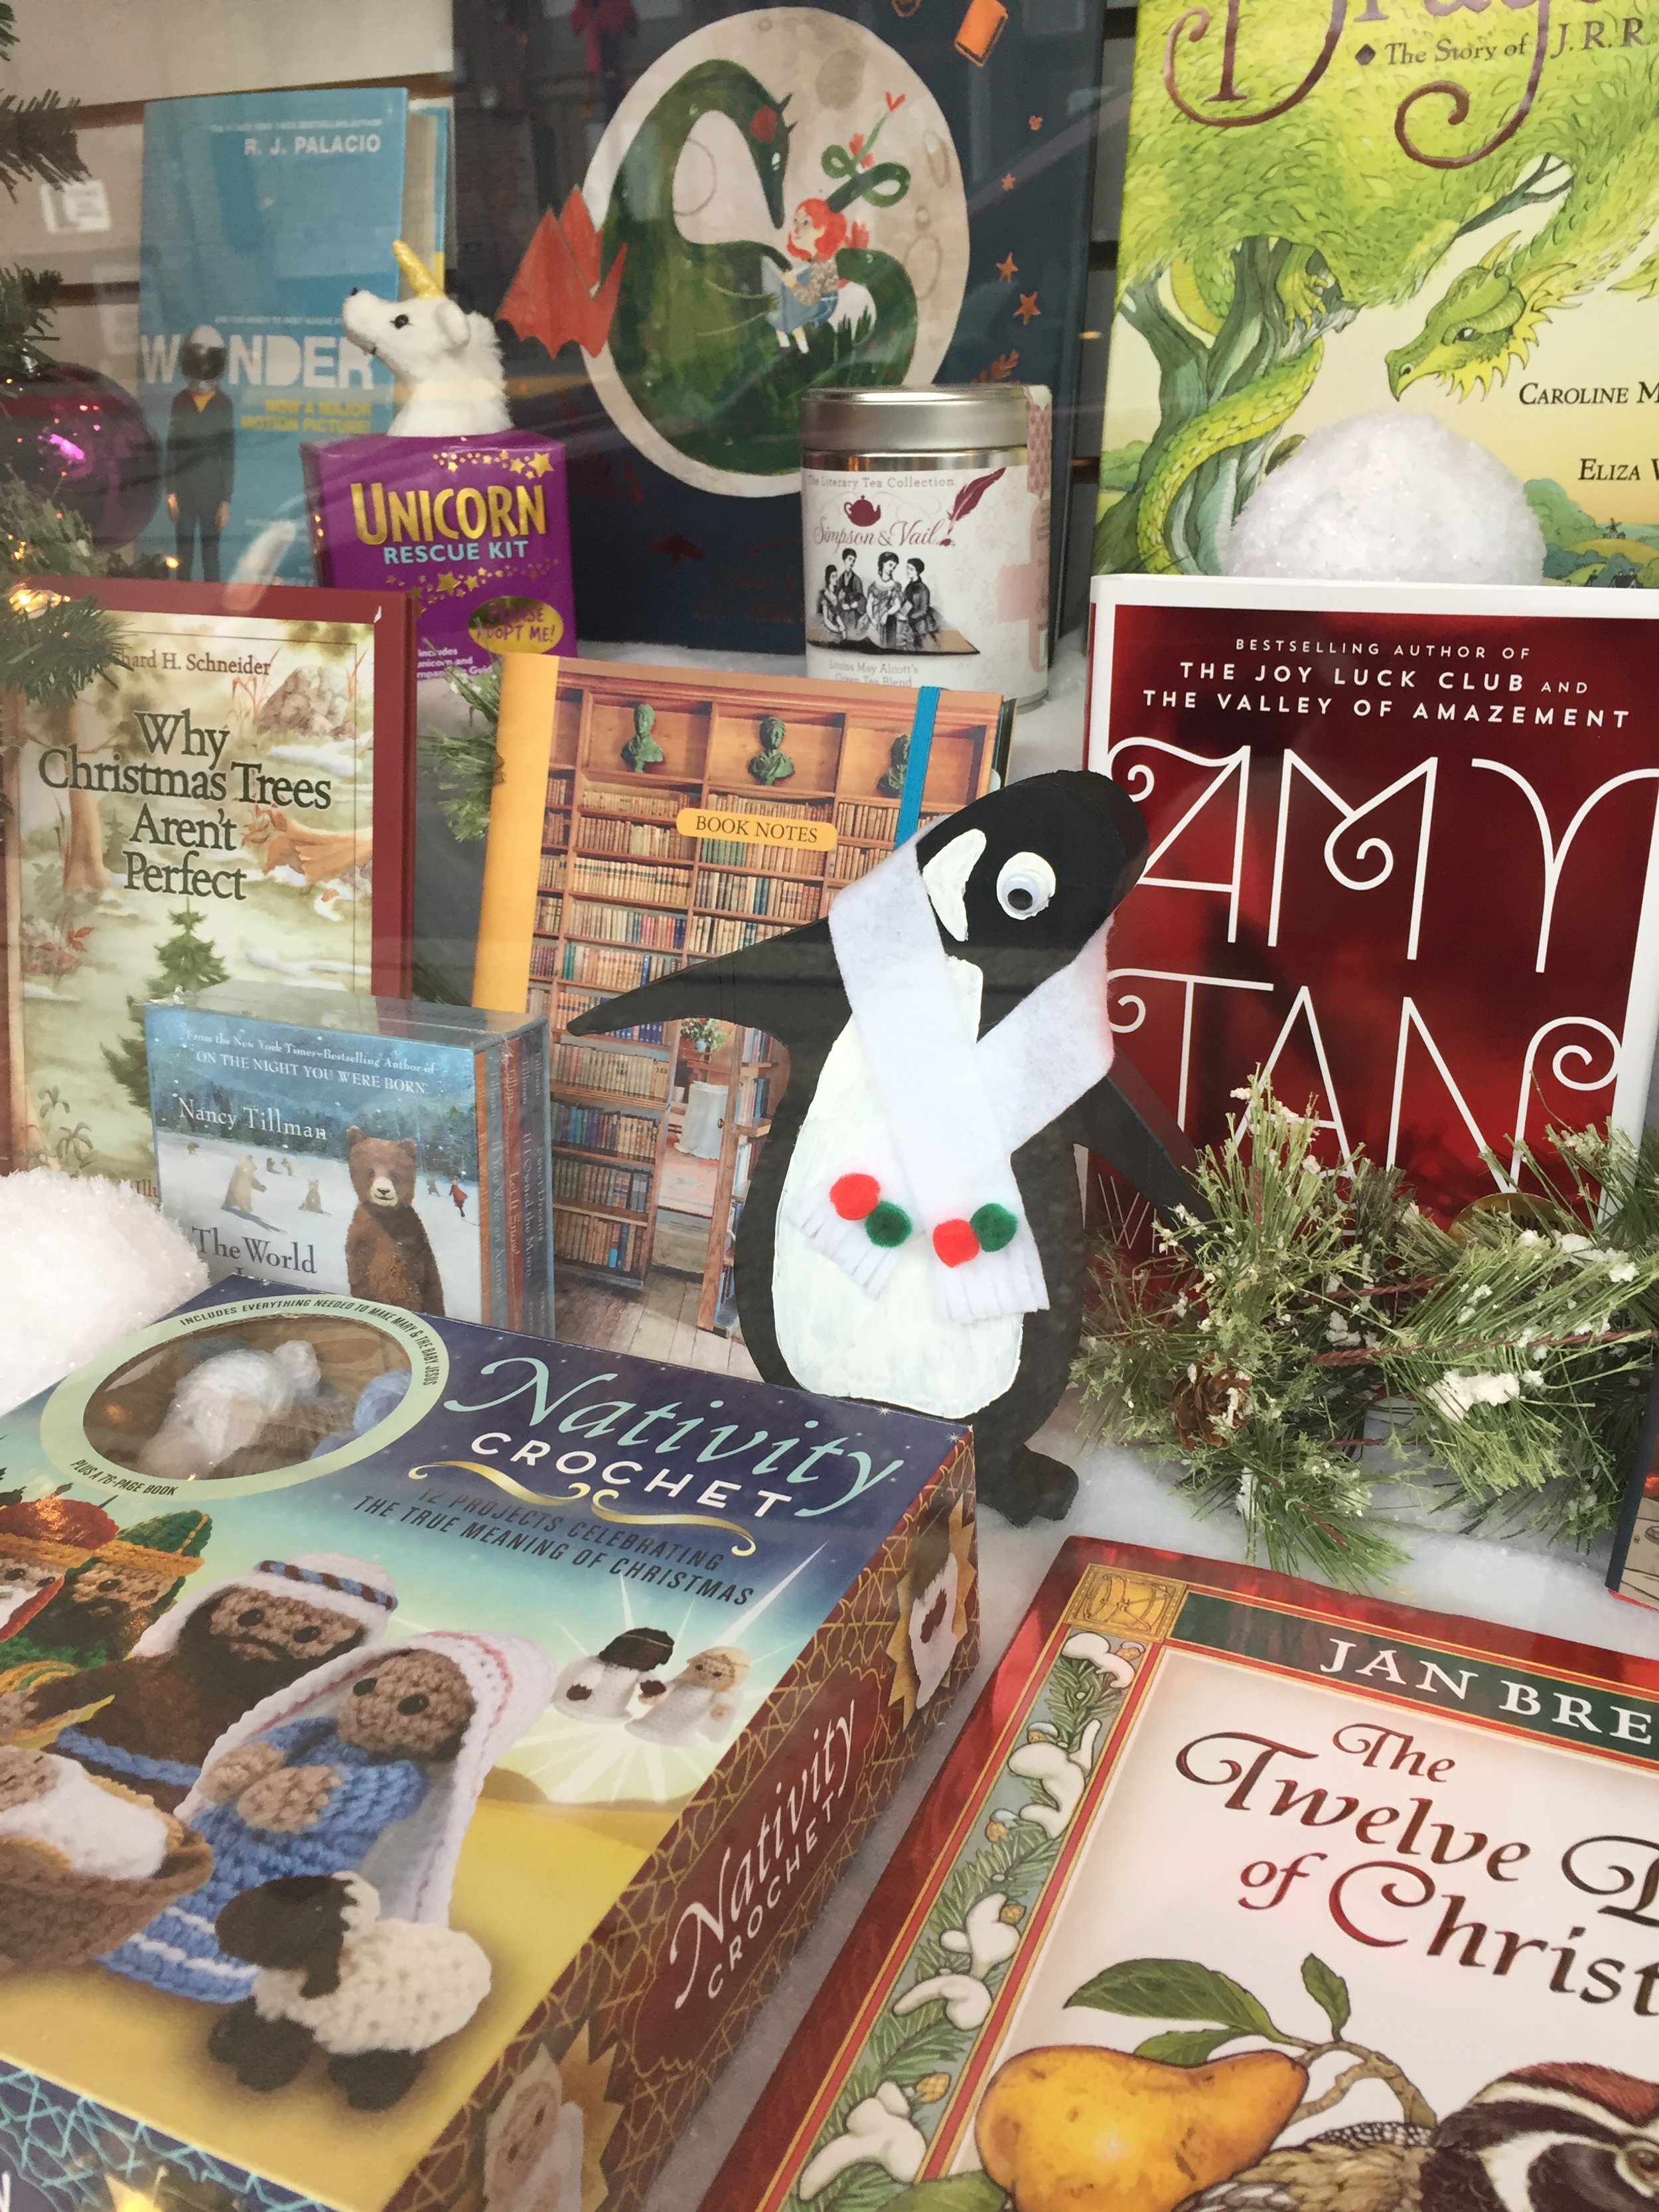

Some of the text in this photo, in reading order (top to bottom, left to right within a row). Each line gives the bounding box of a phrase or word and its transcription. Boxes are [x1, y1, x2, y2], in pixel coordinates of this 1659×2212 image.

[1385, 42, 1426, 65] The
[1434, 38, 1496, 62] Story
[1504, 33, 1529, 57] of
[244, 134, 382, 155] R. J. PALACIO
[1519, 382, 1629, 406] CAROLINE
[822, 477, 859, 490] Literary
[863, 477, 883, 488] Tea
[887, 477, 954, 488] Collection
[1578, 458, 1641, 481] ELIZA
[350, 482, 546, 545] UNICORN
[384, 540, 529, 565] RESCUE KIT
[813, 516, 946, 555] Simpson & Vail
[488, 603, 543, 623] PLEASE
[529, 625, 555, 642] ME!
[1236, 638, 1530, 660] BESTSELLING AUTHOR OF
[161, 652, 181, 670] H.
[186, 652, 271, 676] Schneider
[857, 662, 876, 676] May
[883, 676, 912, 687] Blend
[1180, 662, 1587, 694] THE JOY LUCK CLUB AND
[1143, 690, 1629, 728] THE VALLEY OF AMAZEMENT
[134, 708, 230, 770] Why
[38, 743, 332, 810] Christmas Trees
[129, 802, 238, 851] Aren't
[695, 815, 818, 844] BOOK NOTES
[1107, 735, 1659, 973] AMY
[122, 849, 248, 900] Perfect
[187, 1031, 212, 1043] From
[216, 1034, 230, 1045] the
[234, 1035, 254, 1048] New
[258, 1040, 281, 1053] York
[383, 1057, 421, 1072] Author
[424, 1063, 435, 1074] of
[197, 1051, 216, 1063] ON
[220, 1053, 250, 1069] THE
[253, 1059, 299, 1076] NIGHT
[303, 1065, 332, 1080] YOU
[338, 1070, 381, 1087] WERE
[179, 1097, 328, 1140] Nancy Tillman
[524, 1158, 534, 1208] Owned
[493, 1185, 504, 1221] Were
[192, 1226, 317, 1274] The World
[180, 1307, 237, 1326] INCLUDES
[242, 1299, 312, 1312] EVERYTHING
[314, 1299, 355, 1309] NEEDED
[354, 1303, 369, 1313] TO
[368, 1307, 397, 1321] MAKE
[391, 1316, 419, 1333] MARY
[415, 1335, 433, 1349] THE
[421, 1347, 439, 1364] BABY
[423, 1365, 440, 1386] JESUS
[443, 1357, 904, 1518] Nativity
[70, 1459, 179, 1496] PLUS A 76-PAGE BOOK
[470, 1431, 792, 1520] CROCHET
[353, 1495, 754, 1605] THE TRUE MEANING OF CHRISTMAS
[448, 1493, 564, 1532] PROJECTS
[567, 1520, 724, 1571] CELEBRATING
[1320, 1637, 1479, 1701] JAN
[1332, 1722, 1456, 1783] The
[1175, 1731, 1531, 1883] Twelve
[668, 1699, 856, 2010] Nativity
[707, 1795, 836, 2000] CROCHET
[1237, 1852, 1329, 1911] of
